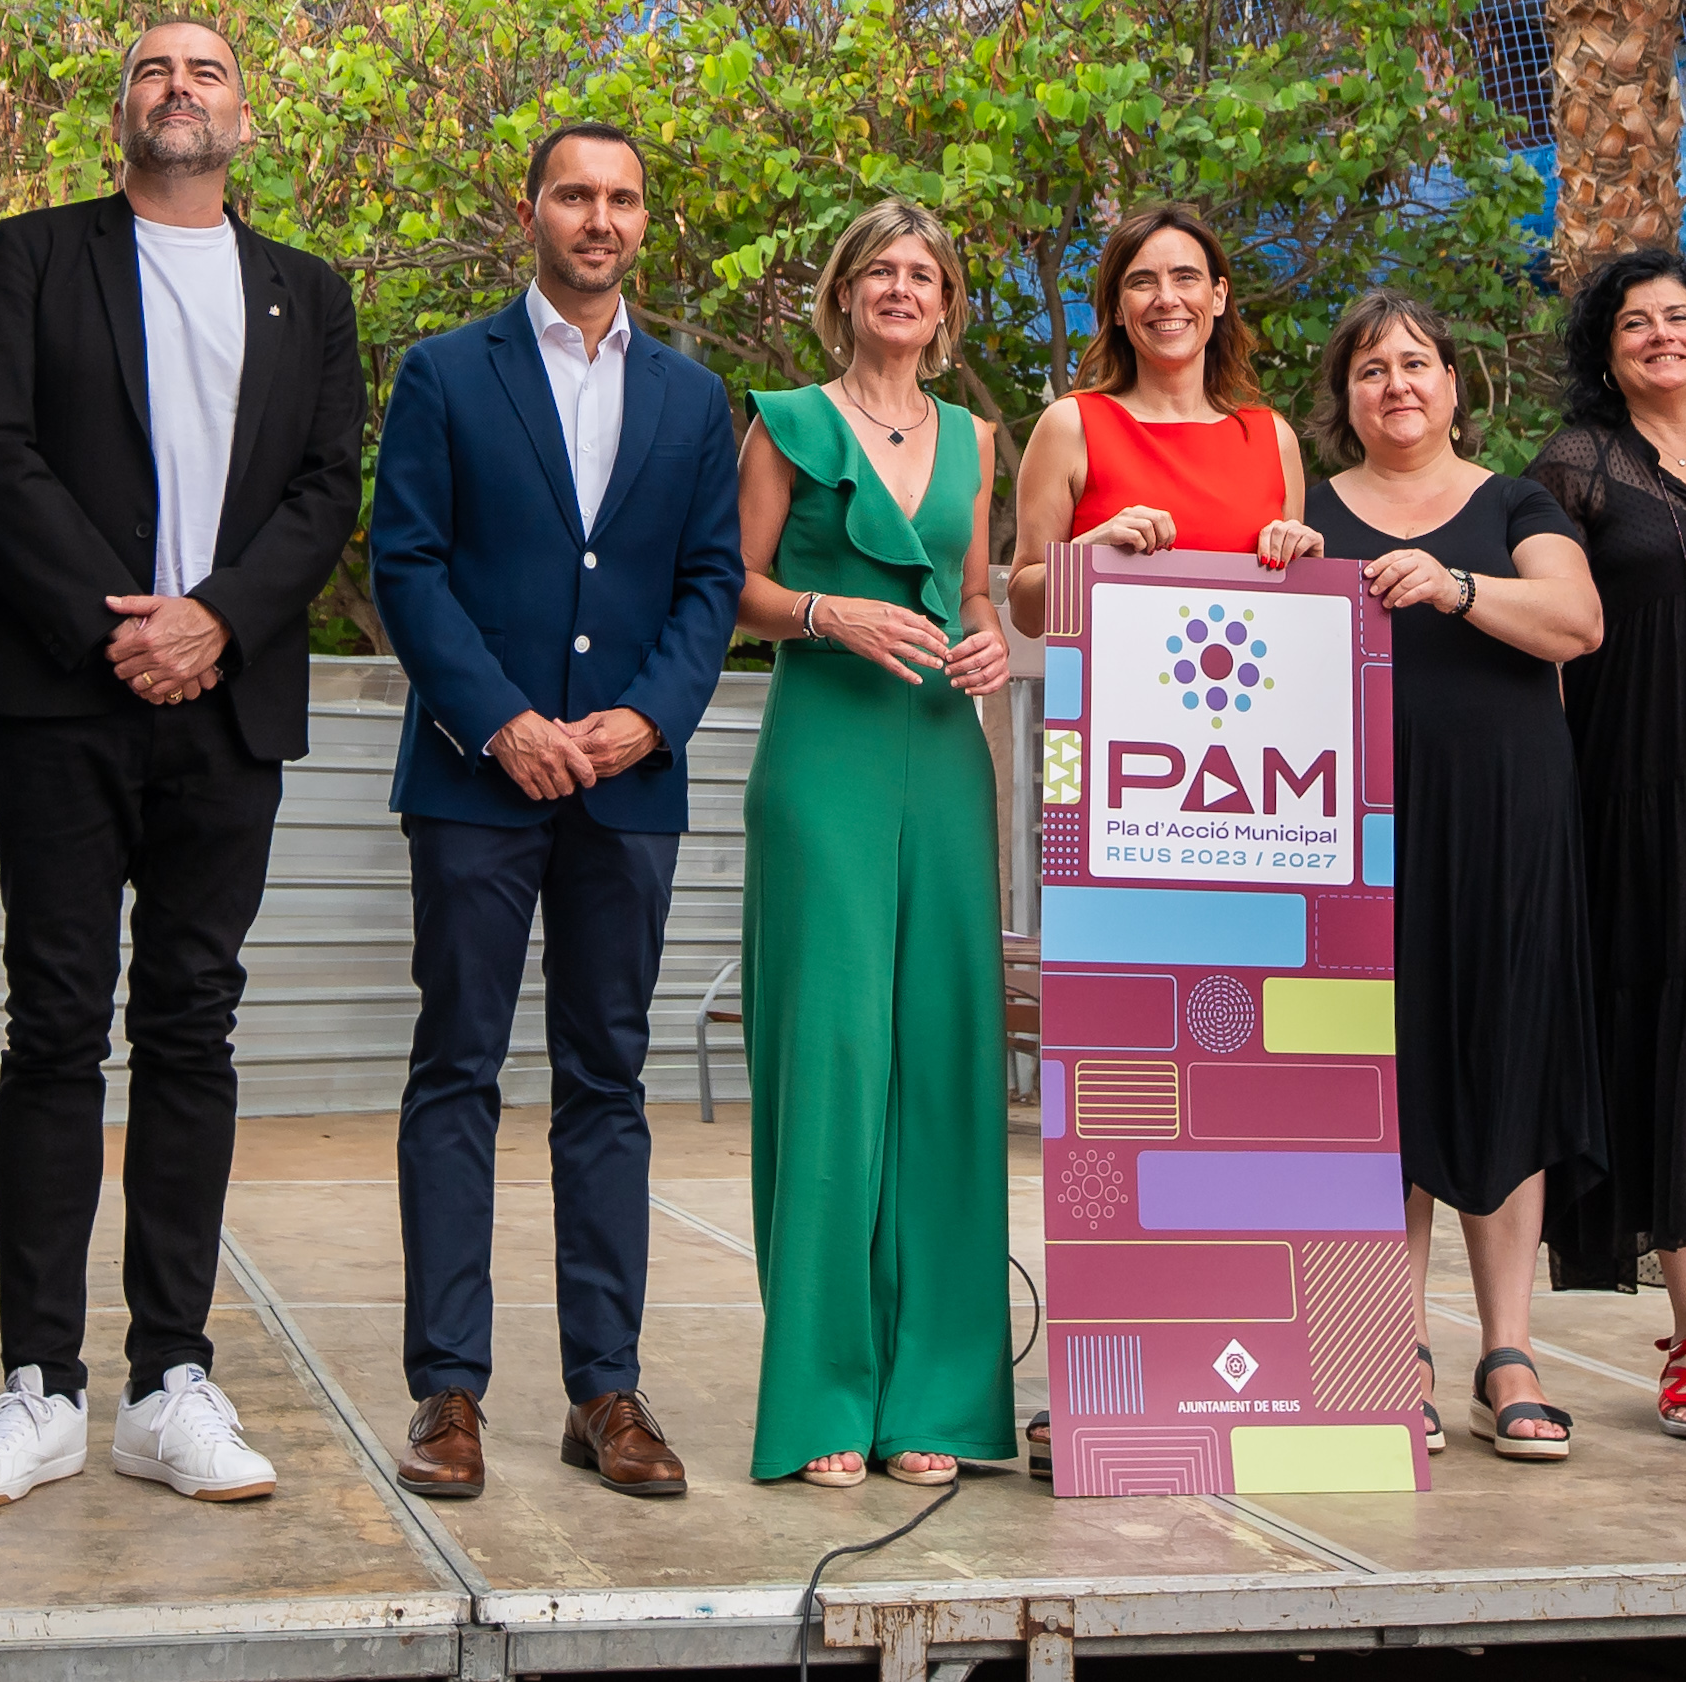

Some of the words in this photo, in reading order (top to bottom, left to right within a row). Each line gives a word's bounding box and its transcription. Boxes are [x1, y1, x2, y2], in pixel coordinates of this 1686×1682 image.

[1108, 740, 1336, 817] PAM
[1107, 820, 1139, 836] Pla
[1234, 825, 1337, 846] Municipal
[1107, 847, 1172, 863] REUS
[1180, 850, 1247, 866] 2023
[1255, 852, 1264, 866] /
[1272, 853, 1337, 869] 2027
[1178, 1401, 1251, 1413] AJUNTAMENT
[1254, 1400, 1270, 1412] DE
[1272, 1400, 1301, 1412] REUS
